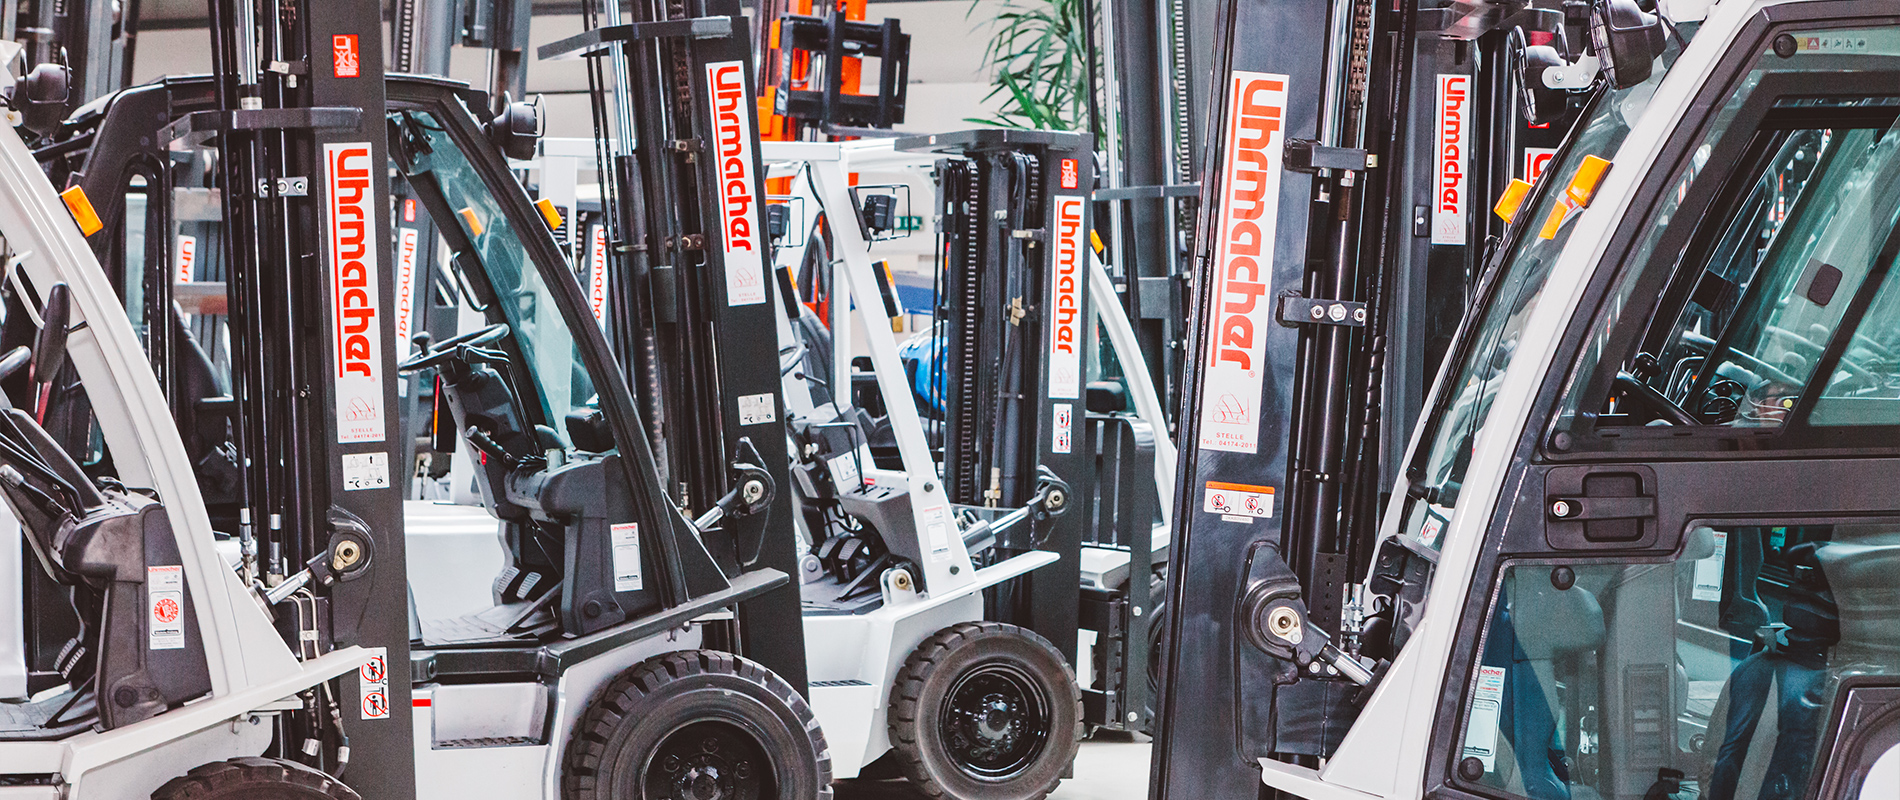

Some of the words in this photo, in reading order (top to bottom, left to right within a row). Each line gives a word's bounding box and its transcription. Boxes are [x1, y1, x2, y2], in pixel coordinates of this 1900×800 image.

[716, 65, 752, 251] Uhrmacher
[1443, 77, 1466, 214] Uhrmacher
[336, 148, 375, 377] Uhrmacher
[398, 233, 415, 340] Uhrmacher
[1057, 200, 1081, 354] Uhrmacher
[1220, 79, 1284, 370] Uhrmacher
[1216, 432, 1244, 440] STELLE
[1219, 440, 1256, 448] 04174-2011
